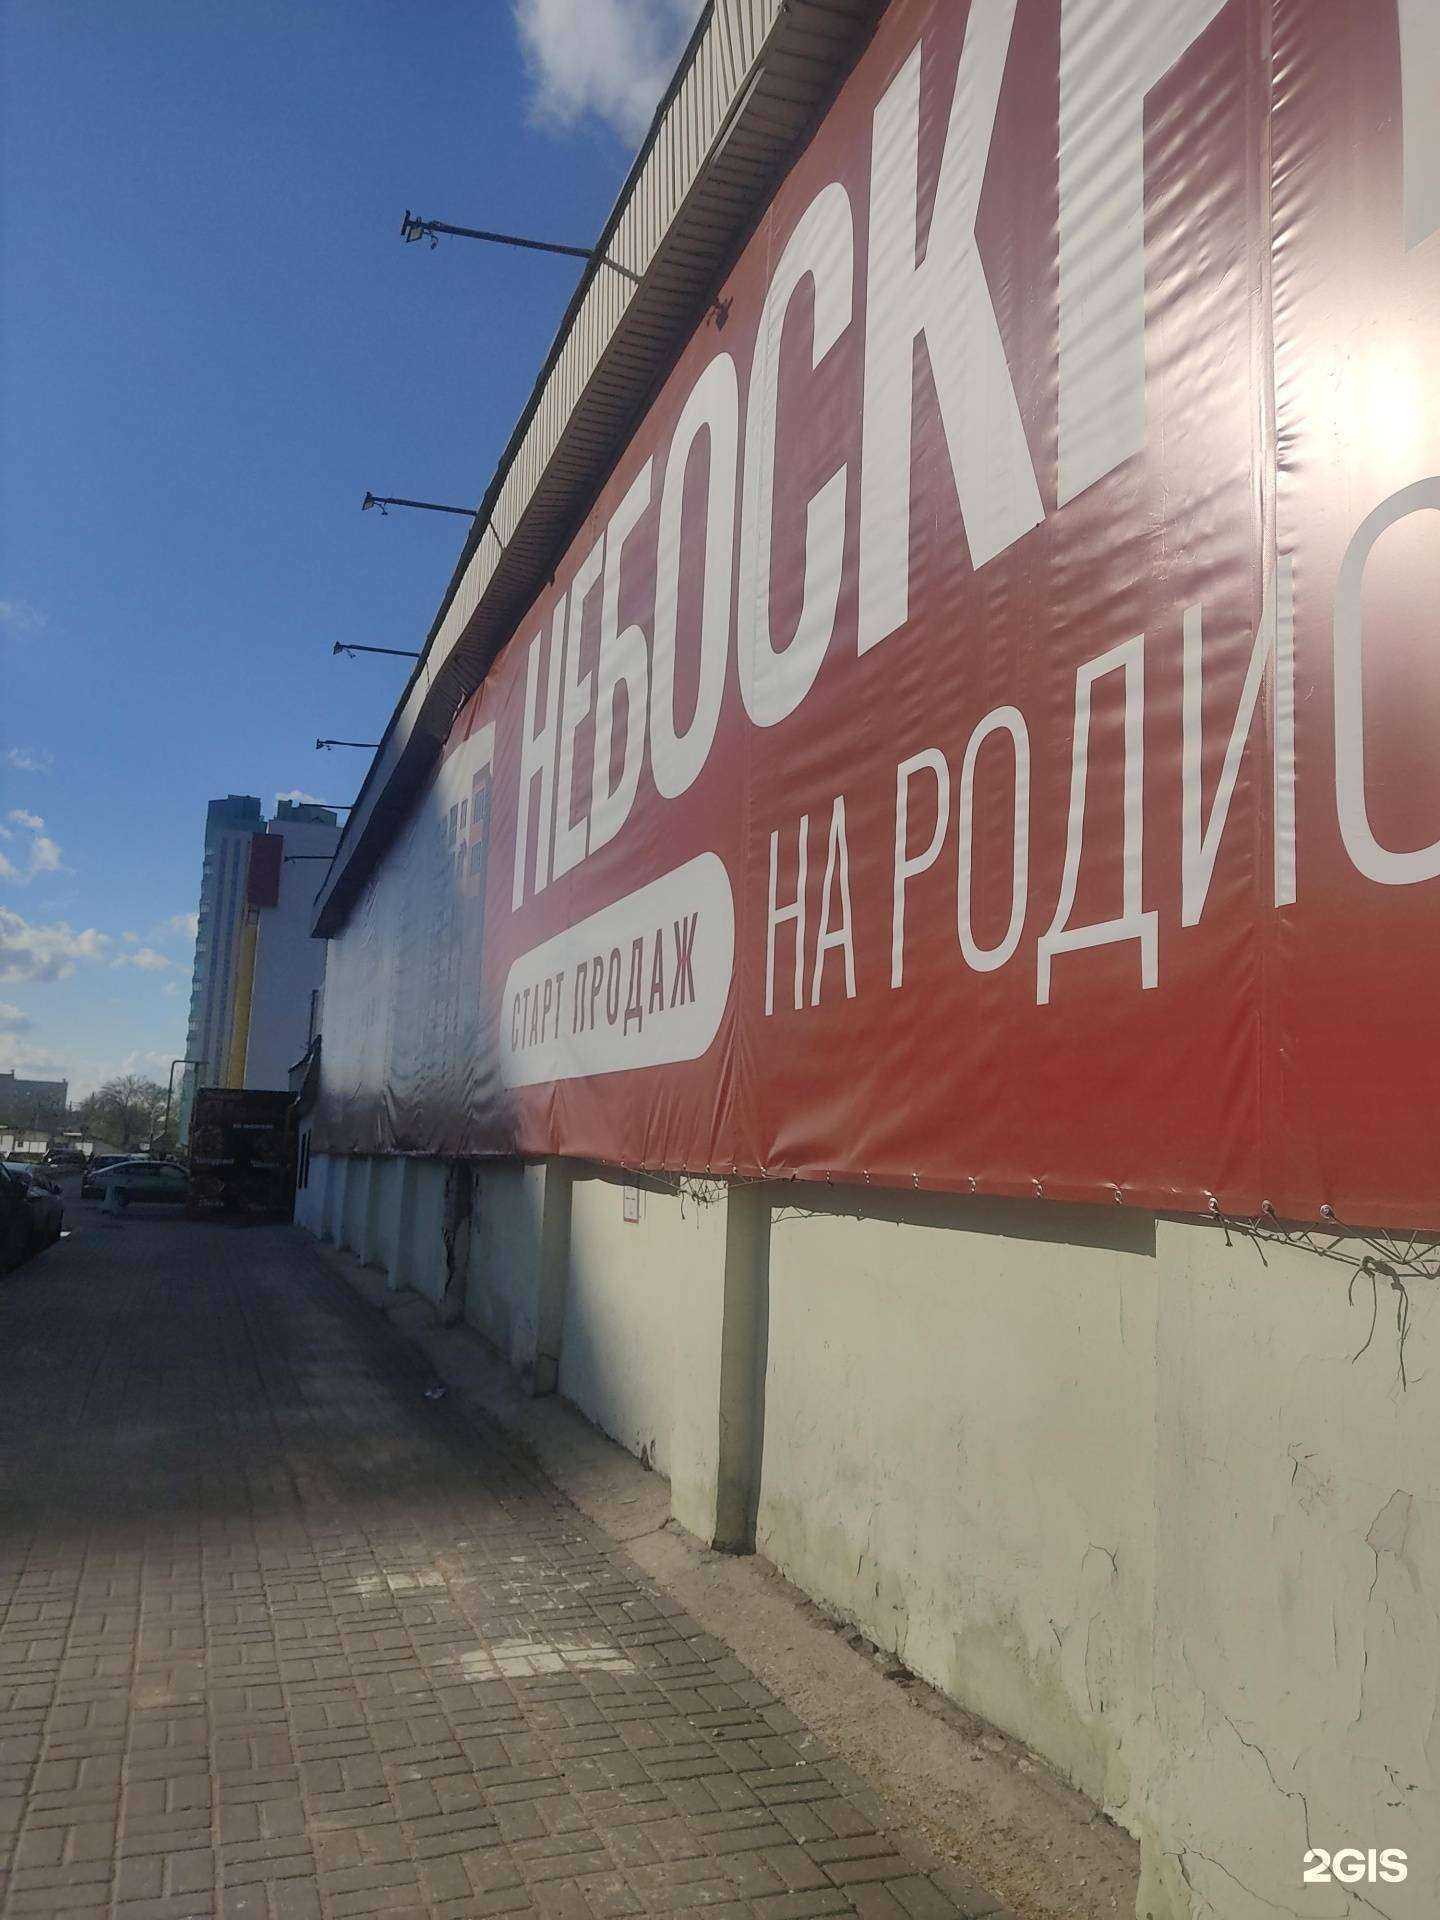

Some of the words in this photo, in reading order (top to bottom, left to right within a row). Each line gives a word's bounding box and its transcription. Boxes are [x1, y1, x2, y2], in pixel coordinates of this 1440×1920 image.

[511, 0, 1440, 913] НЕБОСК
[511, 971, 564, 1052] СТАРТ
[573, 912, 699, 1036] ПРОДАЖ
[765, 795, 857, 1016] НА
